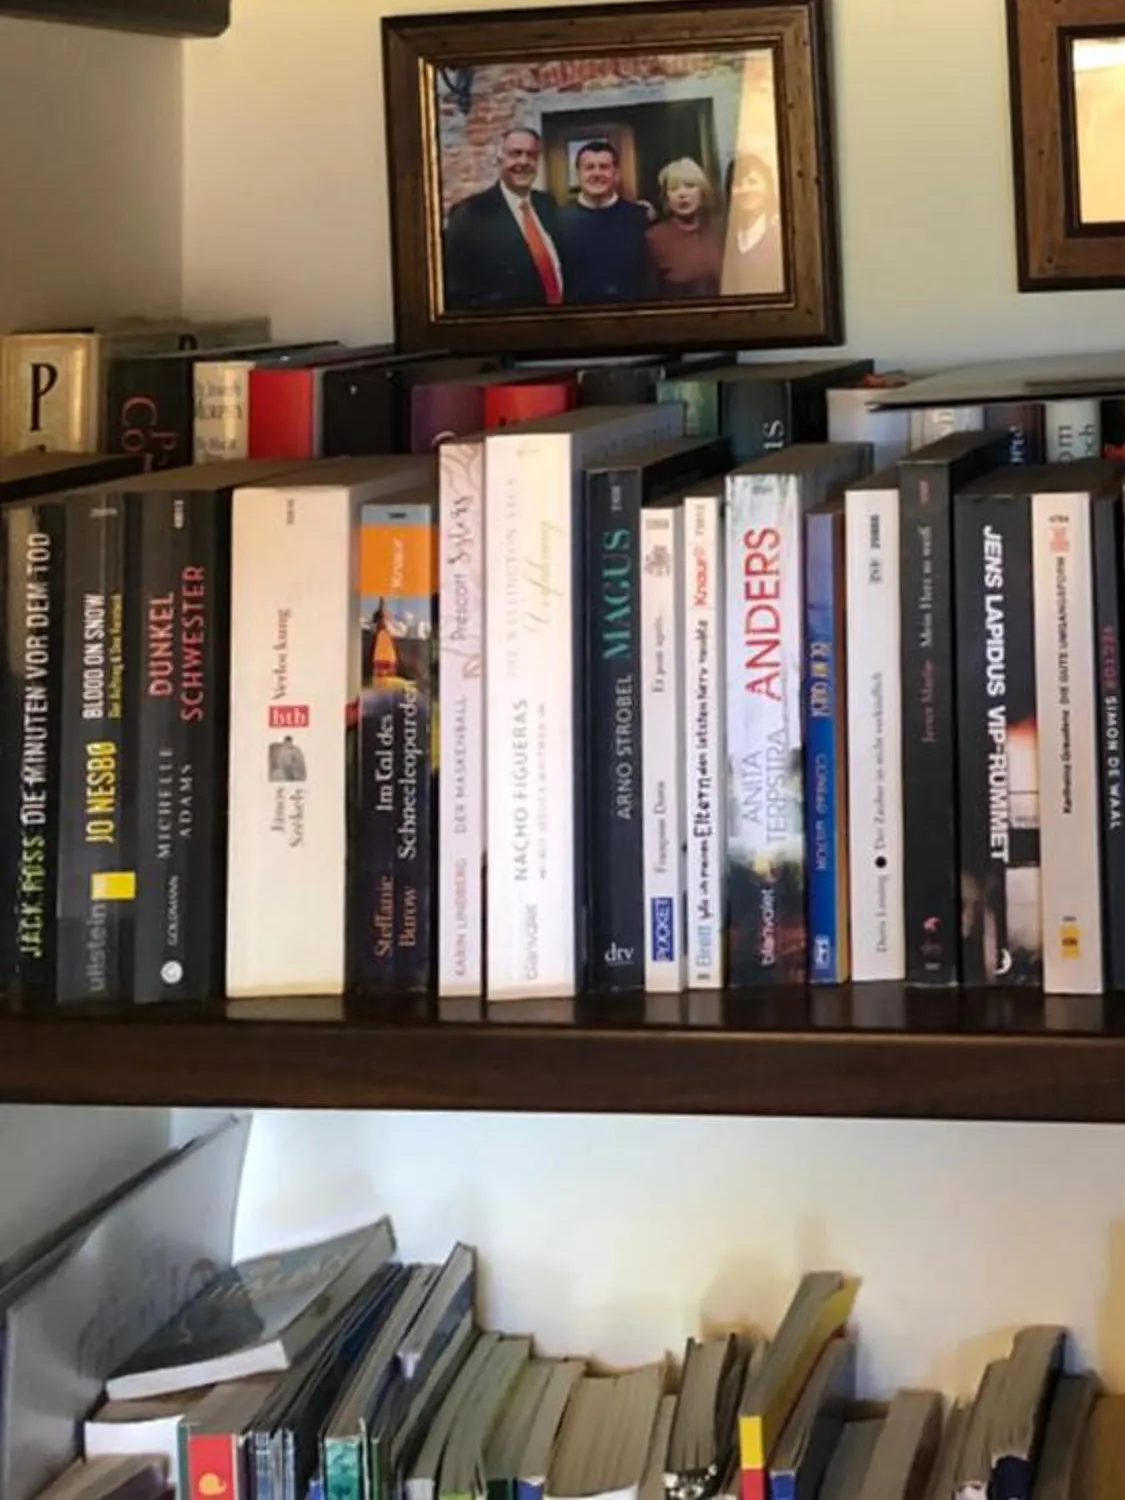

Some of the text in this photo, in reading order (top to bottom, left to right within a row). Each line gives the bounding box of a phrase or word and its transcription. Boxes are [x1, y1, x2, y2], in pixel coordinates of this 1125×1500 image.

[601, 528, 632, 660] MAGUS
[743, 528, 781, 703] ANDERS
[82, 593, 106, 720] BLOOD ON SNOW
[147, 591, 176, 697] DUNKEL
[179, 565, 205, 722] SCHWESTER
[982, 525, 1010, 863] JENS LAPIDUS VIP-RUMMET
[1105, 695, 1119, 751] SIMON
[18, 532, 51, 958] JACK ROSS DIE MINUTEN VOR DEM TOD
[85, 741, 118, 813] NESBØ
[375, 714, 394, 812] Im des
[398, 679, 421, 859] Schneeleoparden
[511, 698, 528, 800] FIGUERAS
[615, 674, 633, 820] ARNO STROBEL
[741, 751, 763, 824] ANITA
[764, 728, 788, 843] TERPSTRA
[1107, 757, 1120, 778] DE
[85, 818, 117, 844] JO
[156, 747, 174, 860] MICHELLE
[178, 762, 193, 838] ADAMS
[512, 806, 529, 882] NACHO
[1108, 783, 1122, 829] WAAL
[85, 905, 107, 993] ullstein
[374, 875, 395, 957] Steffanie
[400, 886, 418, 948] Burow
[653, 897, 673, 961] POCKET
